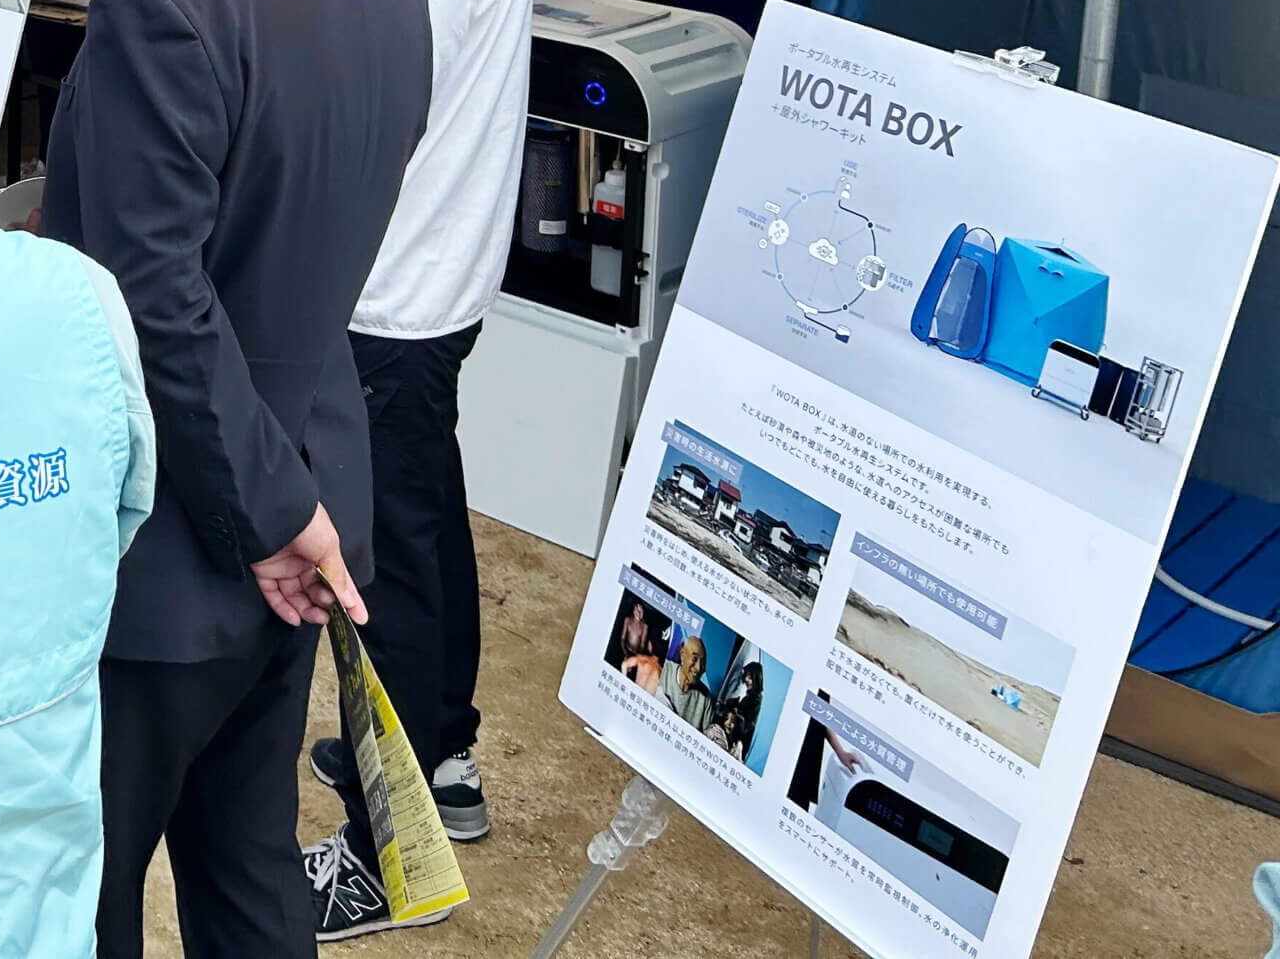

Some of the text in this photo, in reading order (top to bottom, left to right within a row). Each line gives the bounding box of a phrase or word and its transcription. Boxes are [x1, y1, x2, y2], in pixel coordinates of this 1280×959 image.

[787, 41, 899, 88] ポータブル水再生システム
[779, 65, 962, 157] WOTA BOX
[811, 424, 931, 494] ポータブル水再生システムです。
[807, 698, 907, 773] センサーによる水質管理
[777, 819, 856, 885] をスマートにサポート。
